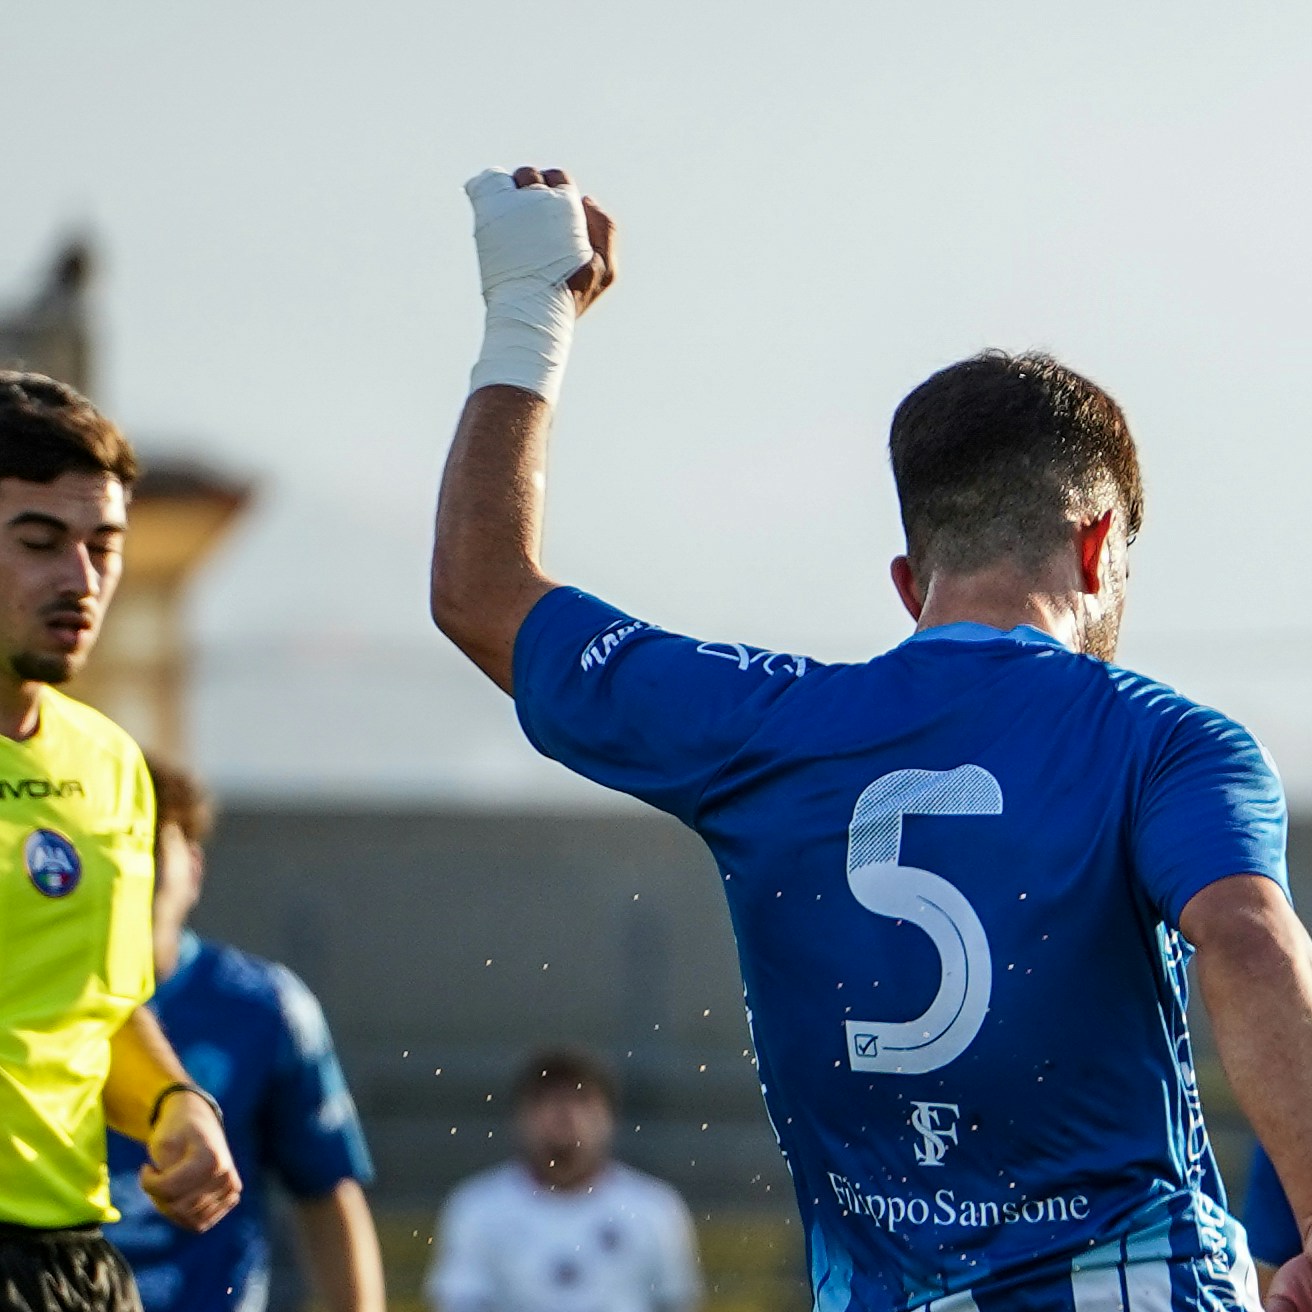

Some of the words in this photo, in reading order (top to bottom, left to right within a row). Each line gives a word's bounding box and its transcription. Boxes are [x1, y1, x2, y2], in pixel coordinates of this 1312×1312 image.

[846, 764, 1003, 1075] 5
[827, 1171, 930, 1233] Filippo
[933, 1188, 1091, 1228] Sansone
